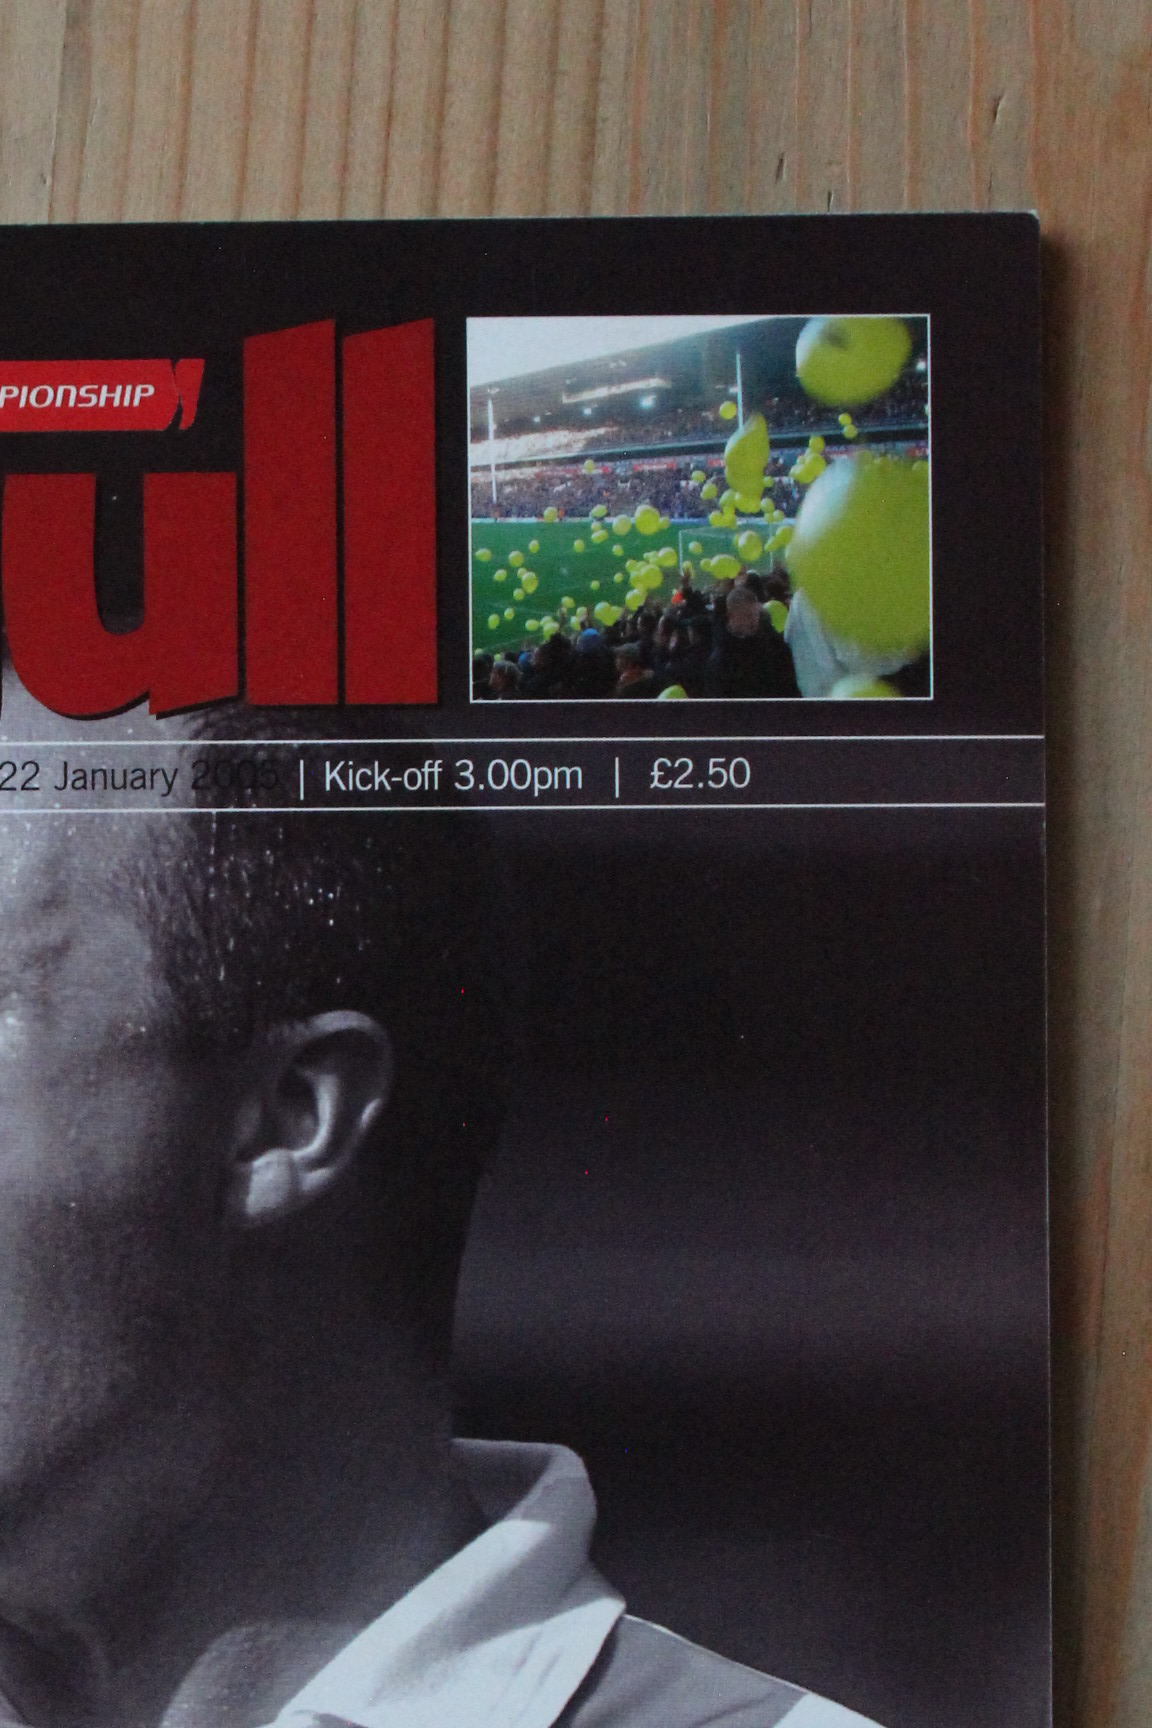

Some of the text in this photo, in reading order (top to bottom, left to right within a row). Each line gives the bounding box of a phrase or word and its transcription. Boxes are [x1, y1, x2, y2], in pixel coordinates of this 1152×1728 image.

[54, 760, 178, 797] January
[325, 759, 442, 792] Kick-off
[454, 759, 583, 796] 3.00pm
[650, 757, 751, 789] £2.50
